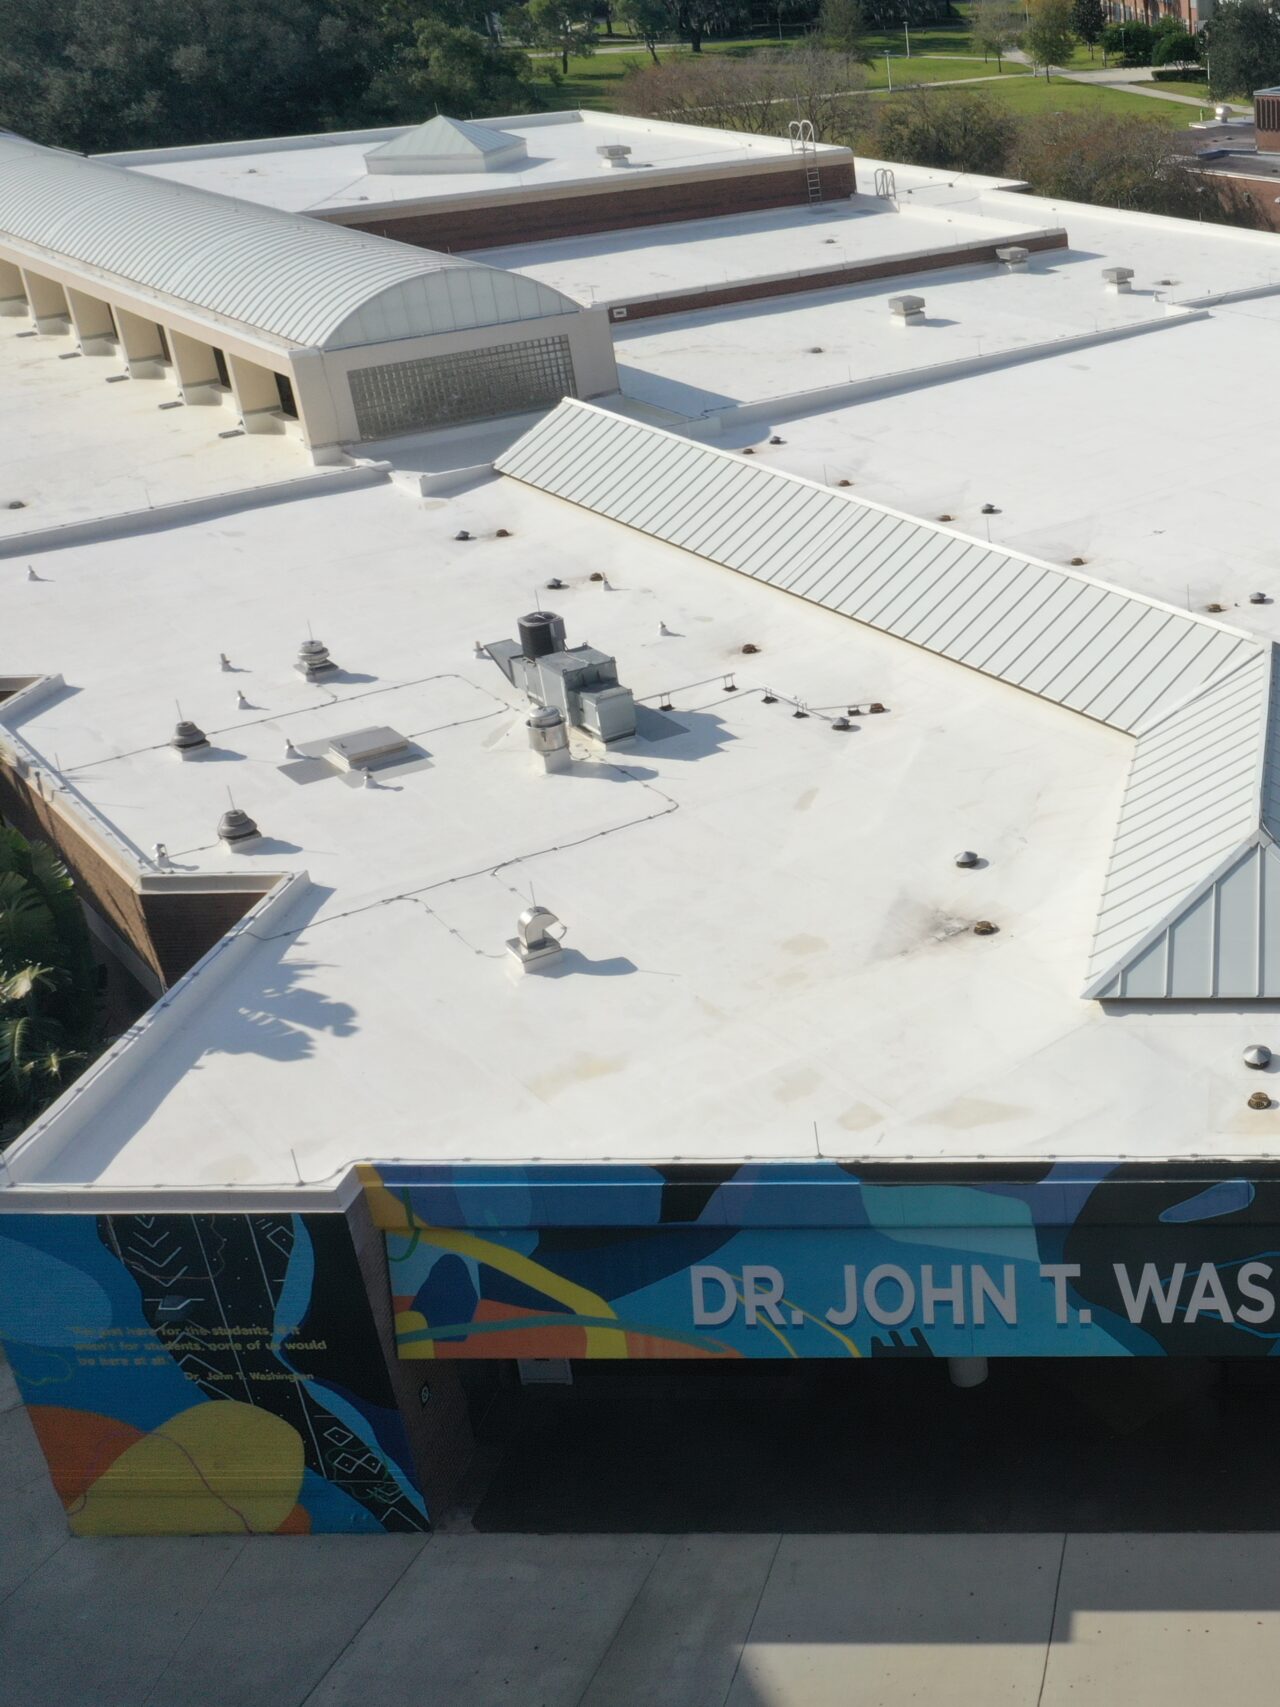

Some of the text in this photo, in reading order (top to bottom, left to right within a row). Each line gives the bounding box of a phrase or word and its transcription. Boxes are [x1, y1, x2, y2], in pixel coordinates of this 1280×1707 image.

[690, 1264, 804, 1326] DR.
[825, 1263, 1018, 1326] JOHN
[1039, 1263, 1092, 1325] T.
[160, 1326, 181, 1336] for
[246, 1339, 261, 1351] of
[284, 1339, 328, 1351] would
[206, 1371, 233, 1381] John
[249, 1370, 315, 1384] Washingn
